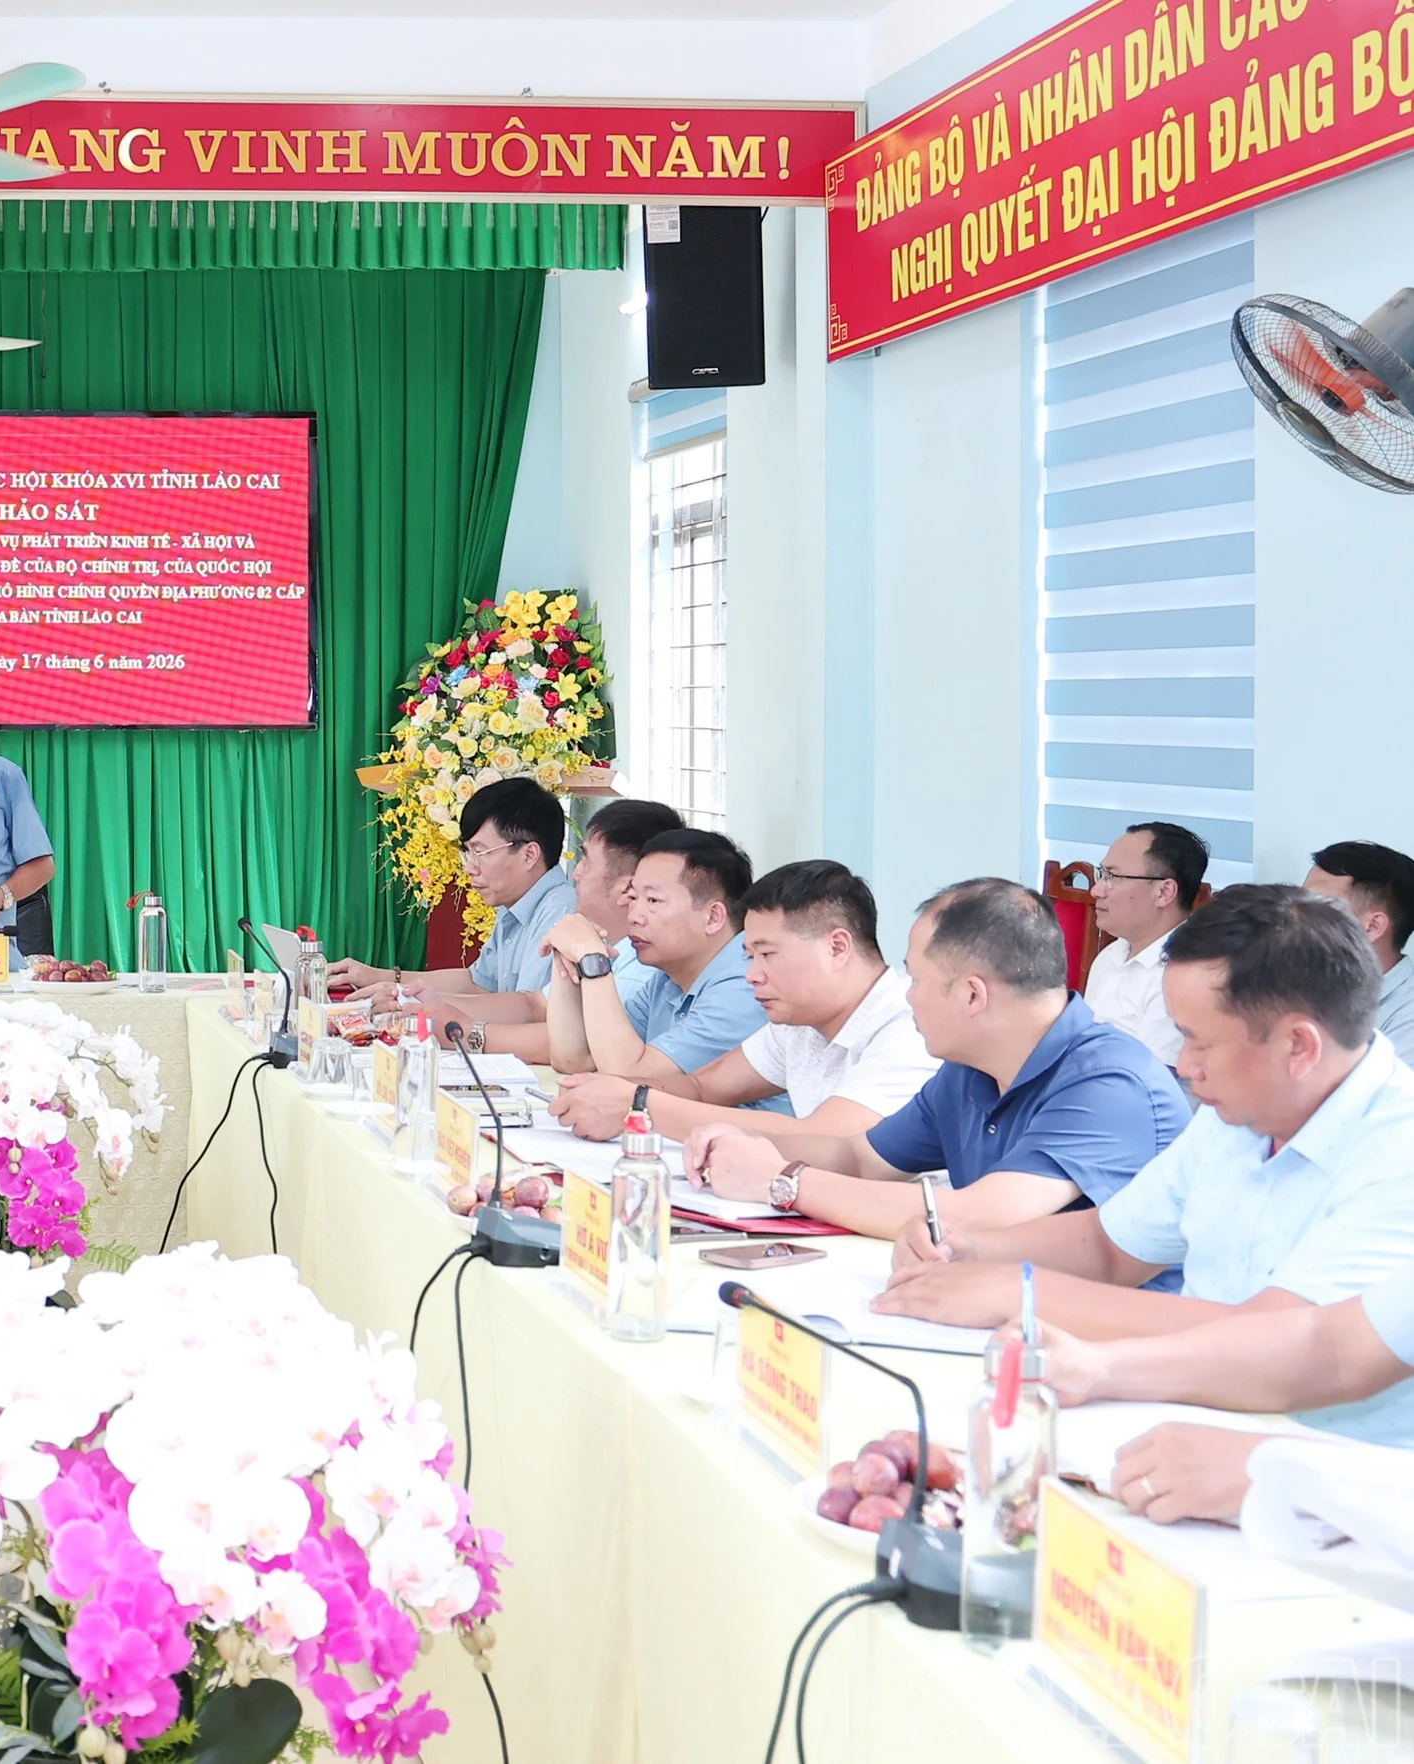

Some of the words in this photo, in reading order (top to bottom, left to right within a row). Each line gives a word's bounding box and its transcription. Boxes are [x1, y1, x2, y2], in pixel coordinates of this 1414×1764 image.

[185, 129, 368, 175] VINH
[381, 116, 591, 178] MUÔN
[856, 151, 922, 233] ĐẢNG
[929, 114, 965, 199] BỘ
[971, 91, 1012, 174] VÀ
[1019, 45, 1113, 153] NHÂN
[1124, 0, 1205, 102] DÂN
[891, 222, 953, 303] NGHỊ
[960, 163, 1053, 278] QUYẾT
[1062, 147, 1120, 237] ĐẠI
[1131, 106, 1196, 209] HỘI
[1208, 58, 1335, 174] ĐẢNG
[22, 653, 42, 669] 17
[44, 653, 91, 673] tháng
[93, 653, 105, 669] 6
[108, 655, 144, 669] năm
[146, 653, 186, 669] 2026
